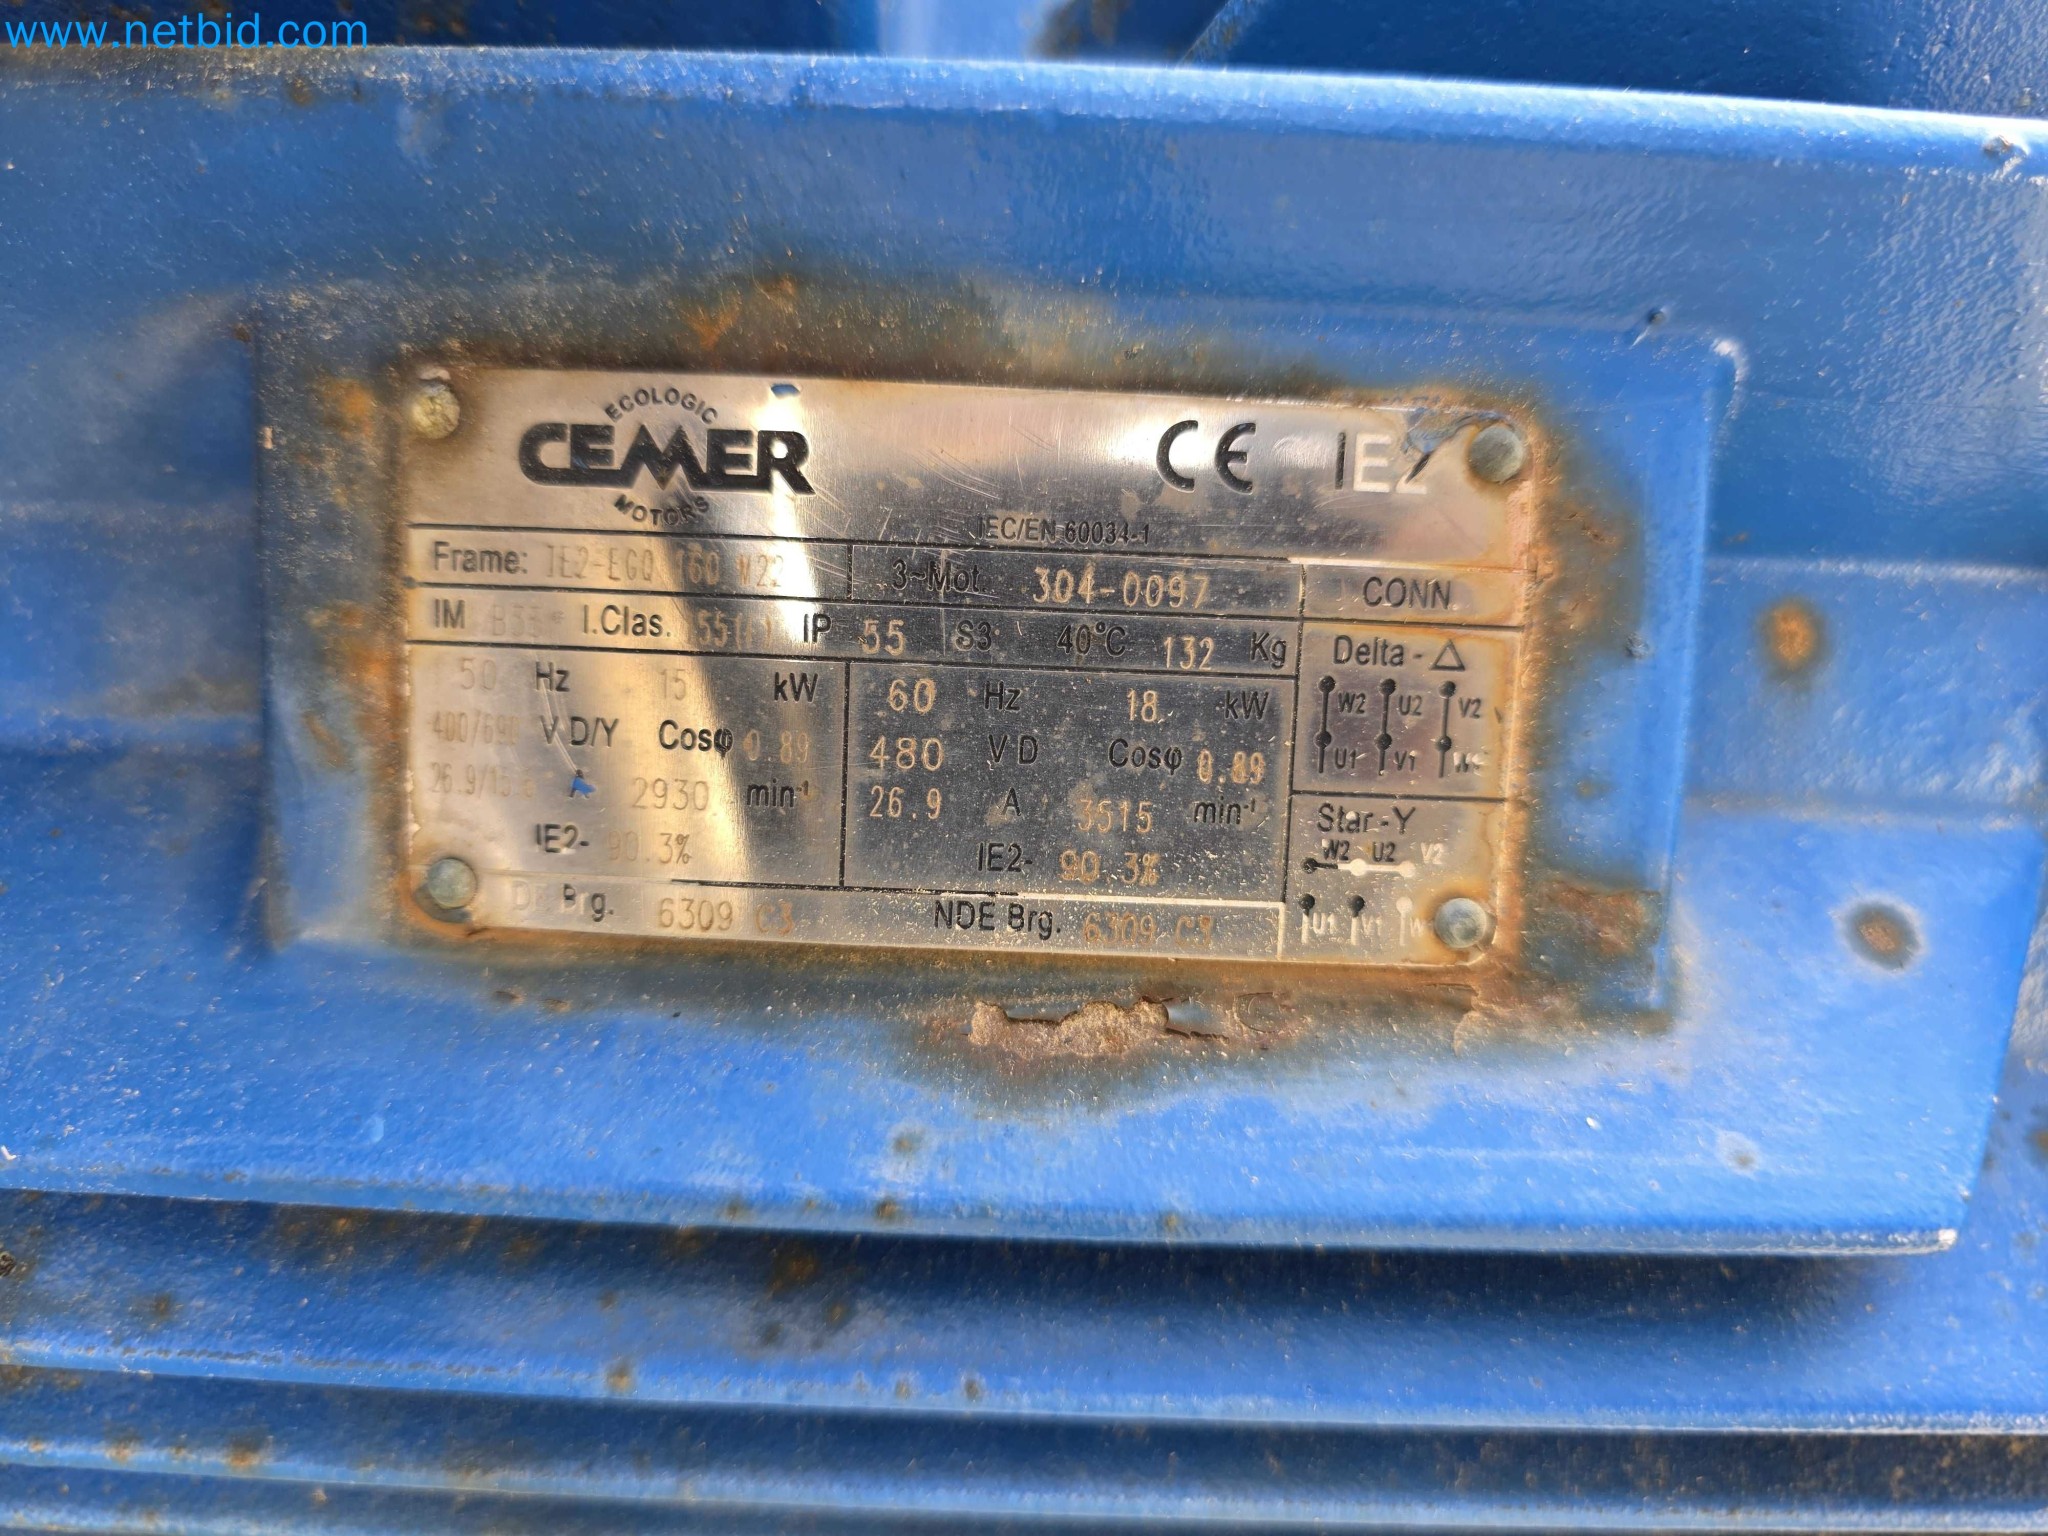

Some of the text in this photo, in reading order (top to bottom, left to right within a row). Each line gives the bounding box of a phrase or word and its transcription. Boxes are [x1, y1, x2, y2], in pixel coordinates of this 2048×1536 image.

[604, 386, 718, 425] ECOLOGIC
[518, 422, 816, 496] CEMER
[614, 494, 709, 526] MOTORS
[977, 516, 1150, 546] IEC/EN 60034-1
[433, 541, 528, 574] Frame:
[1033, 564, 1209, 608] 304-0097
[435, 598, 465, 630] IM
[583, 604, 672, 638] I.Clas.
[803, 613, 832, 643] IP
[861, 618, 905, 656] 55
[954, 619, 1287, 670] S3 40°C 132 Kg
[1332, 635, 1404, 667] Delta
[460, 658, 571, 693] 50 Hz
[661, 668, 819, 702] 15 kW
[887, 679, 1022, 713] 60 Hz
[1127, 688, 1269, 722] 18 kW
[1337, 693, 1482, 719] W2 U2 V2
[570, 716, 619, 748] D/Y
[659, 719, 734, 758] Cosφ
[869, 734, 1039, 772] 480 V D
[1109, 738, 1266, 784] Cosφ 0.89
[1334, 748, 1357, 769] U1
[1395, 751, 1415, 770] V1
[631, 777, 710, 811] 2930
[869, 785, 1022, 820] 26.9 A
[1077, 799, 1152, 833] 3515
[606, 830, 692, 865] 90.3%
[977, 842, 1033, 873] IE2-
[1321, 839, 1445, 864] W2 U2 V2
[658, 898, 795, 936] 6309 C3
[934, 900, 1061, 941] NDE Brg.
[1083, 910, 1157, 946] 6309
[1313, 912, 1335, 935] U1
